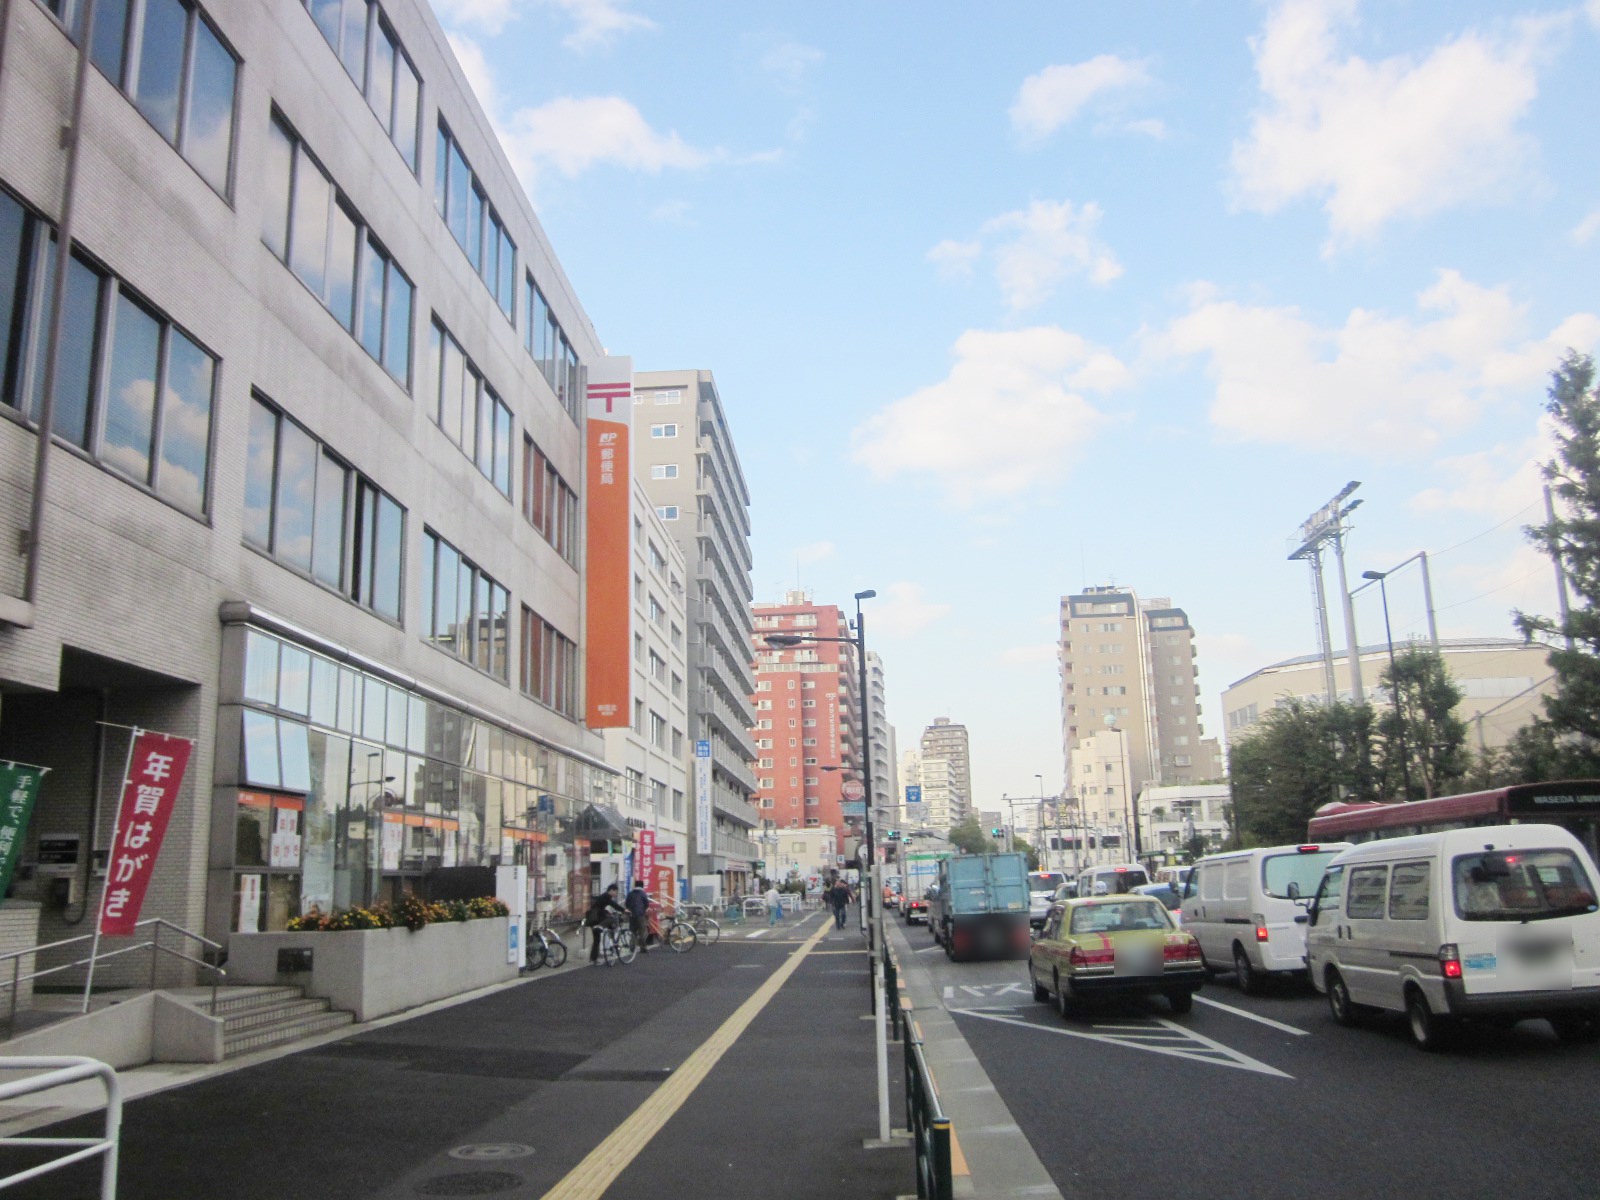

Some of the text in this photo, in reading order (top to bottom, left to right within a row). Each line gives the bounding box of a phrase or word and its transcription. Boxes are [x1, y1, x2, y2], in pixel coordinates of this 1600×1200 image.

[601, 448, 614, 485] 郵便局
[106, 752, 174, 918] 年賀はがき
